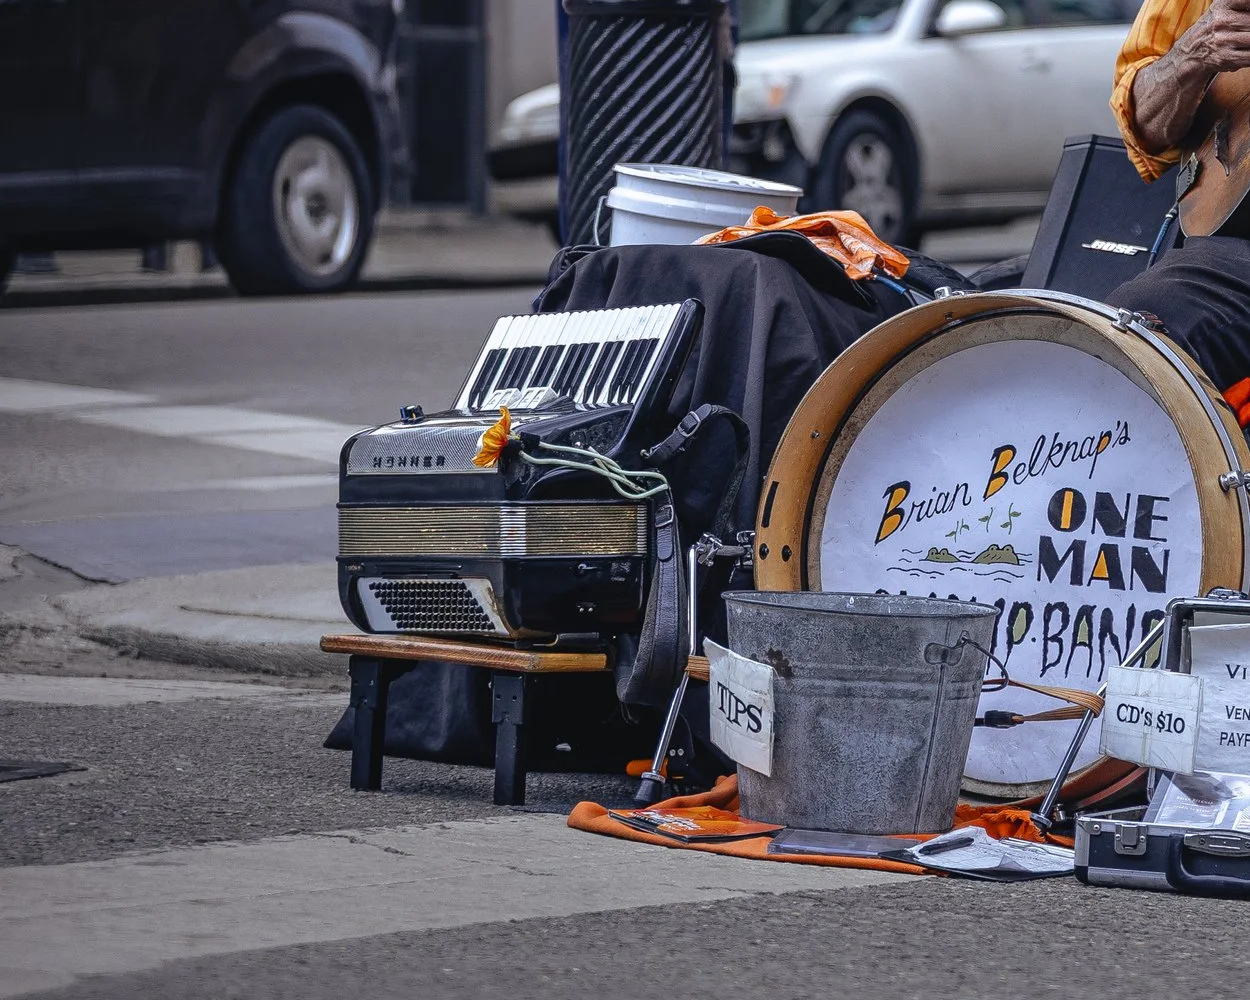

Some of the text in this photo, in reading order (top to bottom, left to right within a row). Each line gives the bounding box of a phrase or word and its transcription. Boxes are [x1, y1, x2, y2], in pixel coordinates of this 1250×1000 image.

[1081, 239, 1149, 256] BOSE
[873, 420, 1131, 546] Brian Belknap's
[1046, 486, 1171, 543] ONE
[1036, 534, 1170, 594] MAN
[717, 681, 763, 734] TIPS
[1116, 703, 1186, 734] CD's $10
